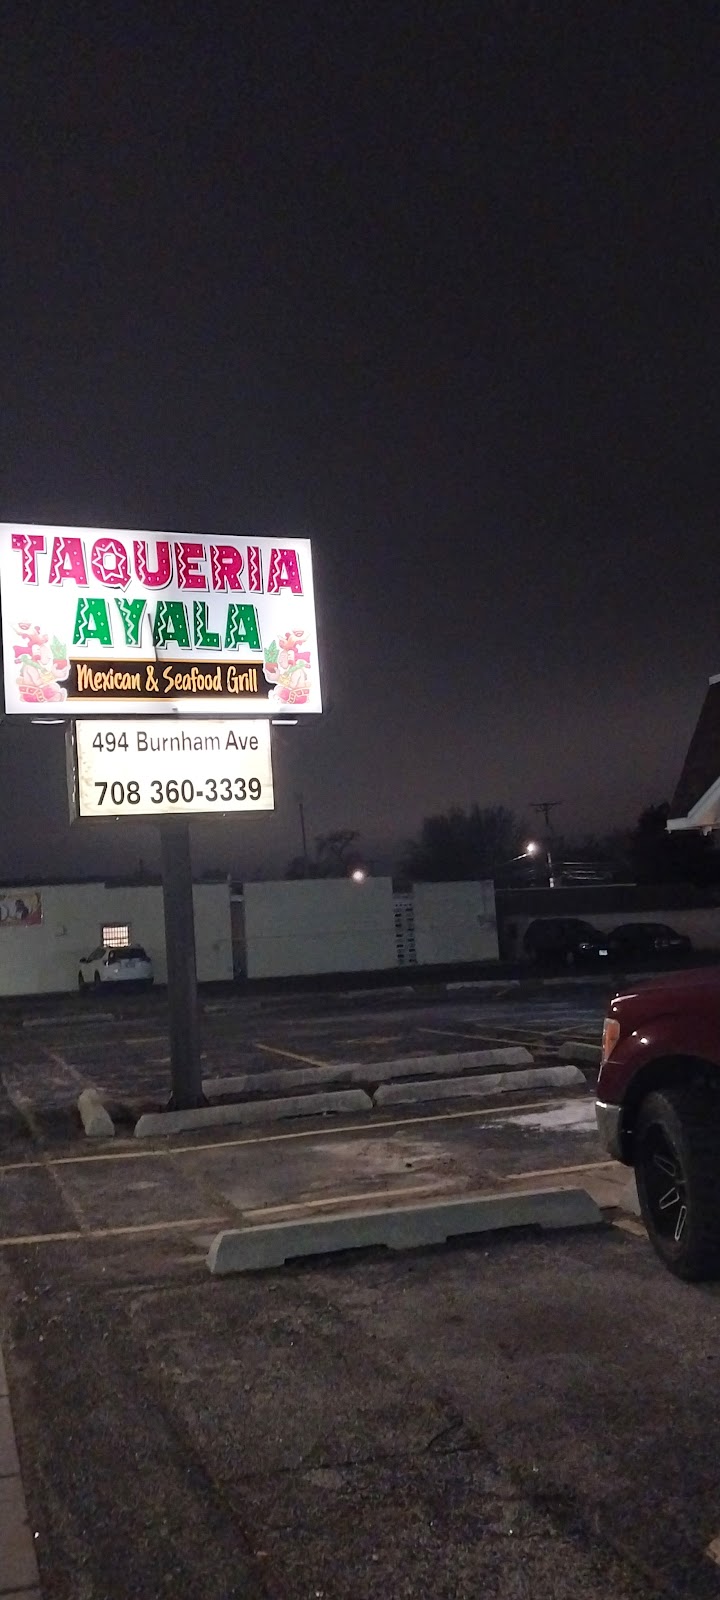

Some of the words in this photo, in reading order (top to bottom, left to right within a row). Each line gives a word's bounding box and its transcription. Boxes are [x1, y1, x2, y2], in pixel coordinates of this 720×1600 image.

[11, 533, 304, 595] TAQUERIA
[72, 597, 263, 652] AYALA
[76, 664, 141, 693] Mexican
[146, 666, 159, 693] &
[163, 666, 222, 694] Seafood
[227, 666, 258, 694] Grill
[92, 732, 129, 753] 494
[137, 731, 220, 752] Burnham
[225, 730, 259, 751] Ave
[94, 780, 141, 806] 708
[150, 777, 262, 805] 360-3339
